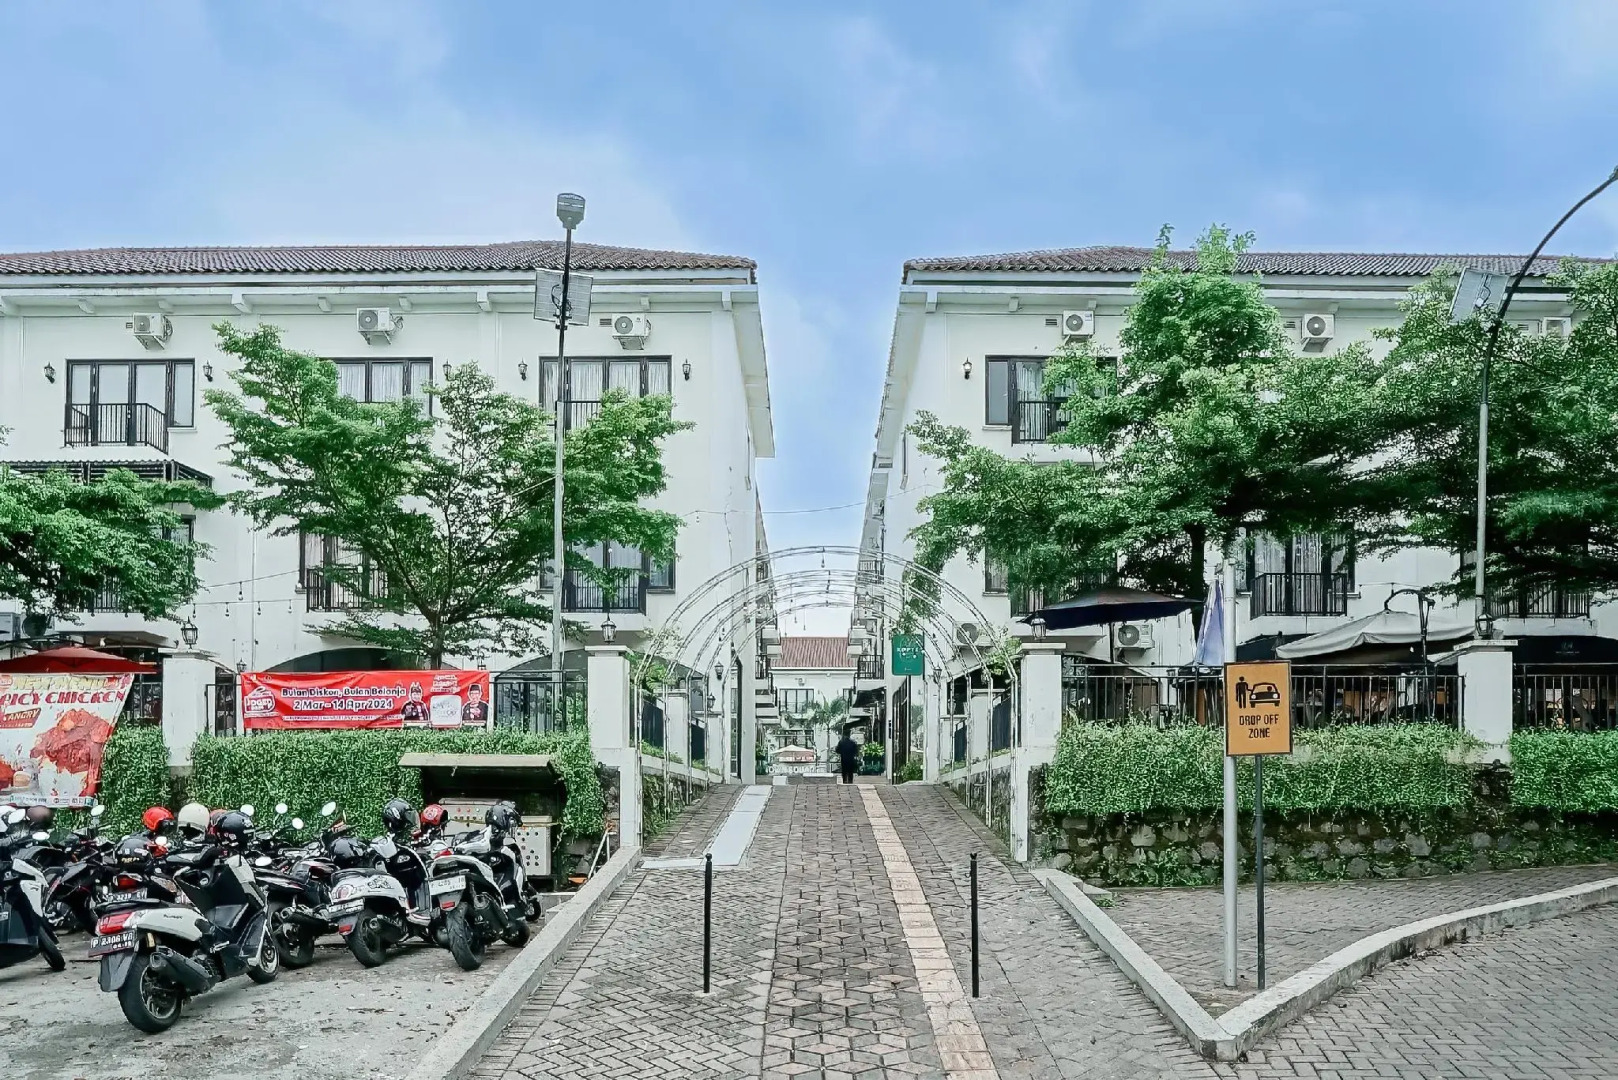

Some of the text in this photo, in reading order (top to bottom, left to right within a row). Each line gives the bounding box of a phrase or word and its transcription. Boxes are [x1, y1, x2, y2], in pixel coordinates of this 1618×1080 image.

[13, 676, 52, 690] NEW
[45, 690, 126, 704] CHICKEN
[282, 687, 406, 698] Bulan Diskon, Bulan Belanja
[294, 700, 301, 710] 2
[302, 700, 324, 710] Mar
[332, 700, 344, 710] 14
[346, 700, 367, 712] Apr
[367, 700, 393, 710] 2024
[8, 709, 39, 720] ANGRY
[1239, 714, 1280, 726] DROP OFF
[1248, 727, 1270, 738] ZONE
